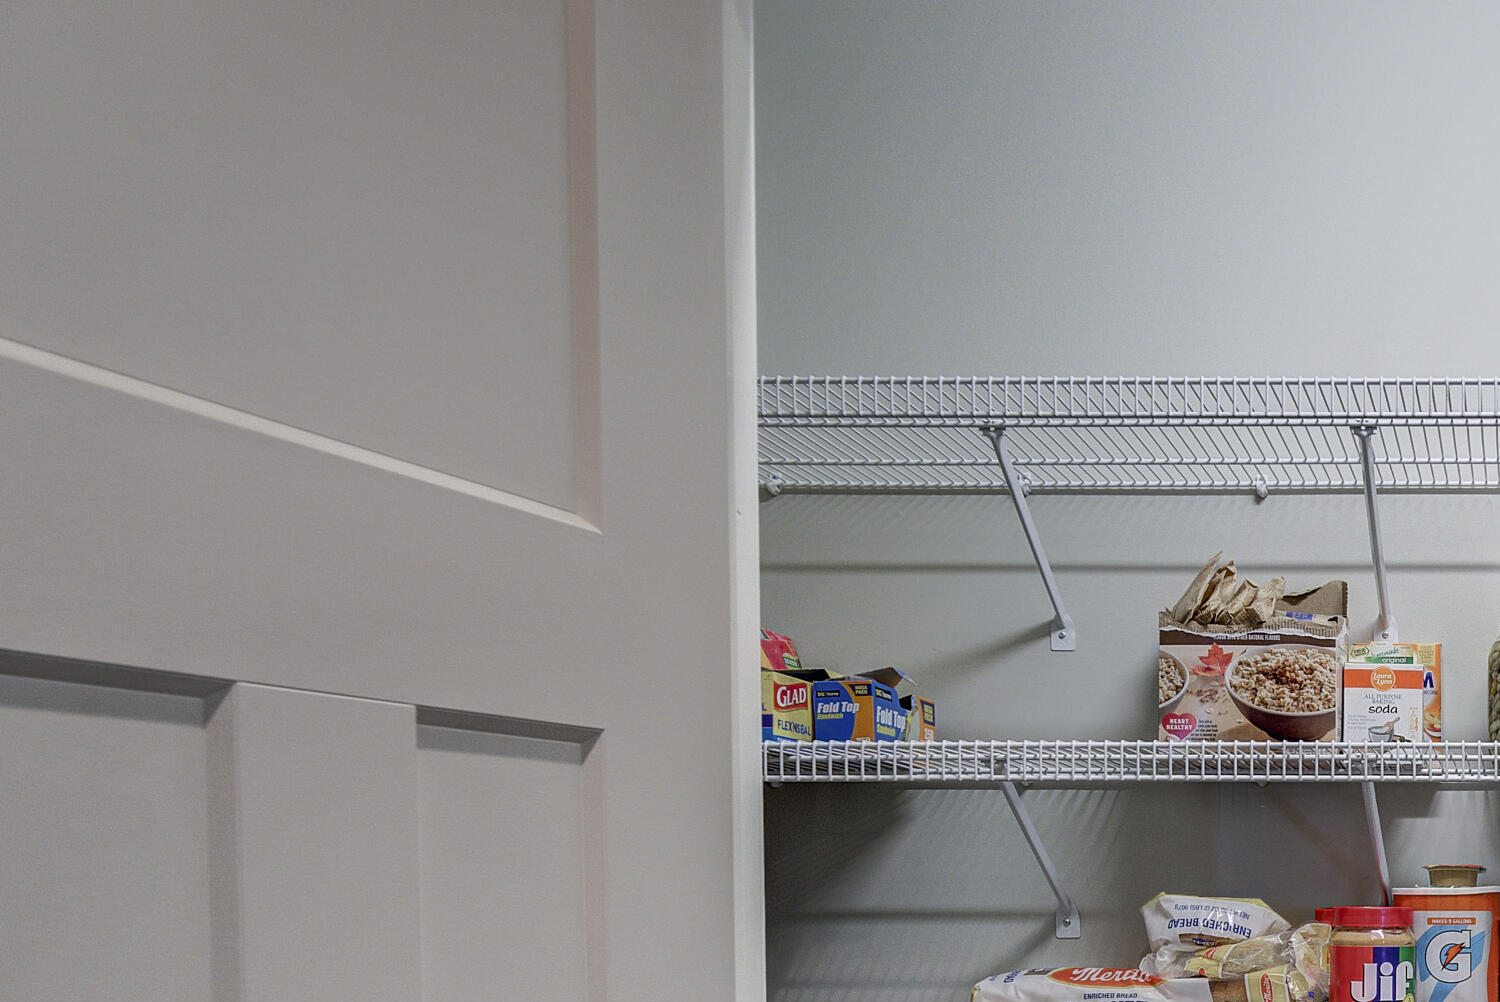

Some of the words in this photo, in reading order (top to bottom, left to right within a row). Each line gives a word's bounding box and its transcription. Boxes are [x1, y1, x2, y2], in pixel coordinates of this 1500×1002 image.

[1373, 672, 1392, 680] Laura
[1377, 678, 1393, 687] Lynn
[776, 686, 807, 708] GLAD
[817, 702, 840, 714] Fold
[841, 701, 860, 714] Top
[1368, 704, 1398, 714] soda
[876, 706, 893, 726] Fold
[1168, 917, 1199, 929] BREAD
[1425, 930, 1472, 983] G
[1350, 961, 1414, 1002] Jif
